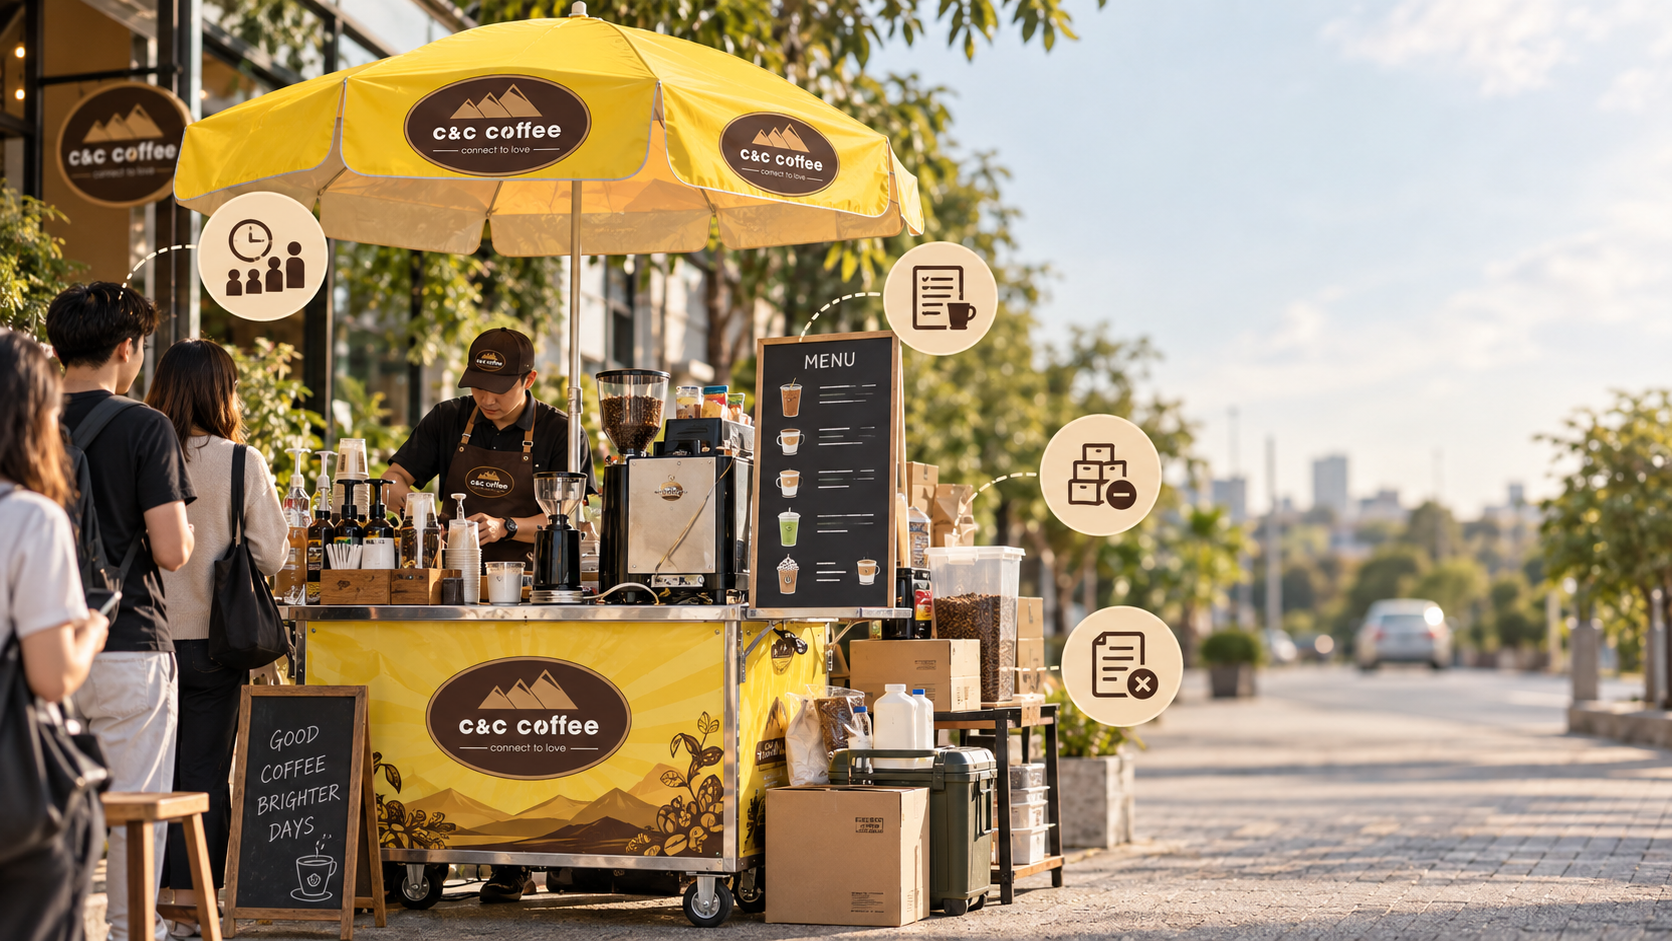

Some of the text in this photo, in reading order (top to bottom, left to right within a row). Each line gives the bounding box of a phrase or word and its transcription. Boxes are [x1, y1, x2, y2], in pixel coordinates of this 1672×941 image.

[432, 122, 562, 140] c&c coffee
[68, 141, 176, 166] c&c coffee
[461, 145, 530, 154] connect to love
[740, 148, 823, 172] c&c coffee
[804, 352, 856, 370] MENU
[458, 715, 599, 735] c&c coffee
[270, 725, 320, 752] GOOD
[490, 743, 567, 753] connect to love
[260, 754, 326, 784] COFFEE
[257, 784, 341, 816] BRIGHTER
[268, 816, 315, 843] DAYS
